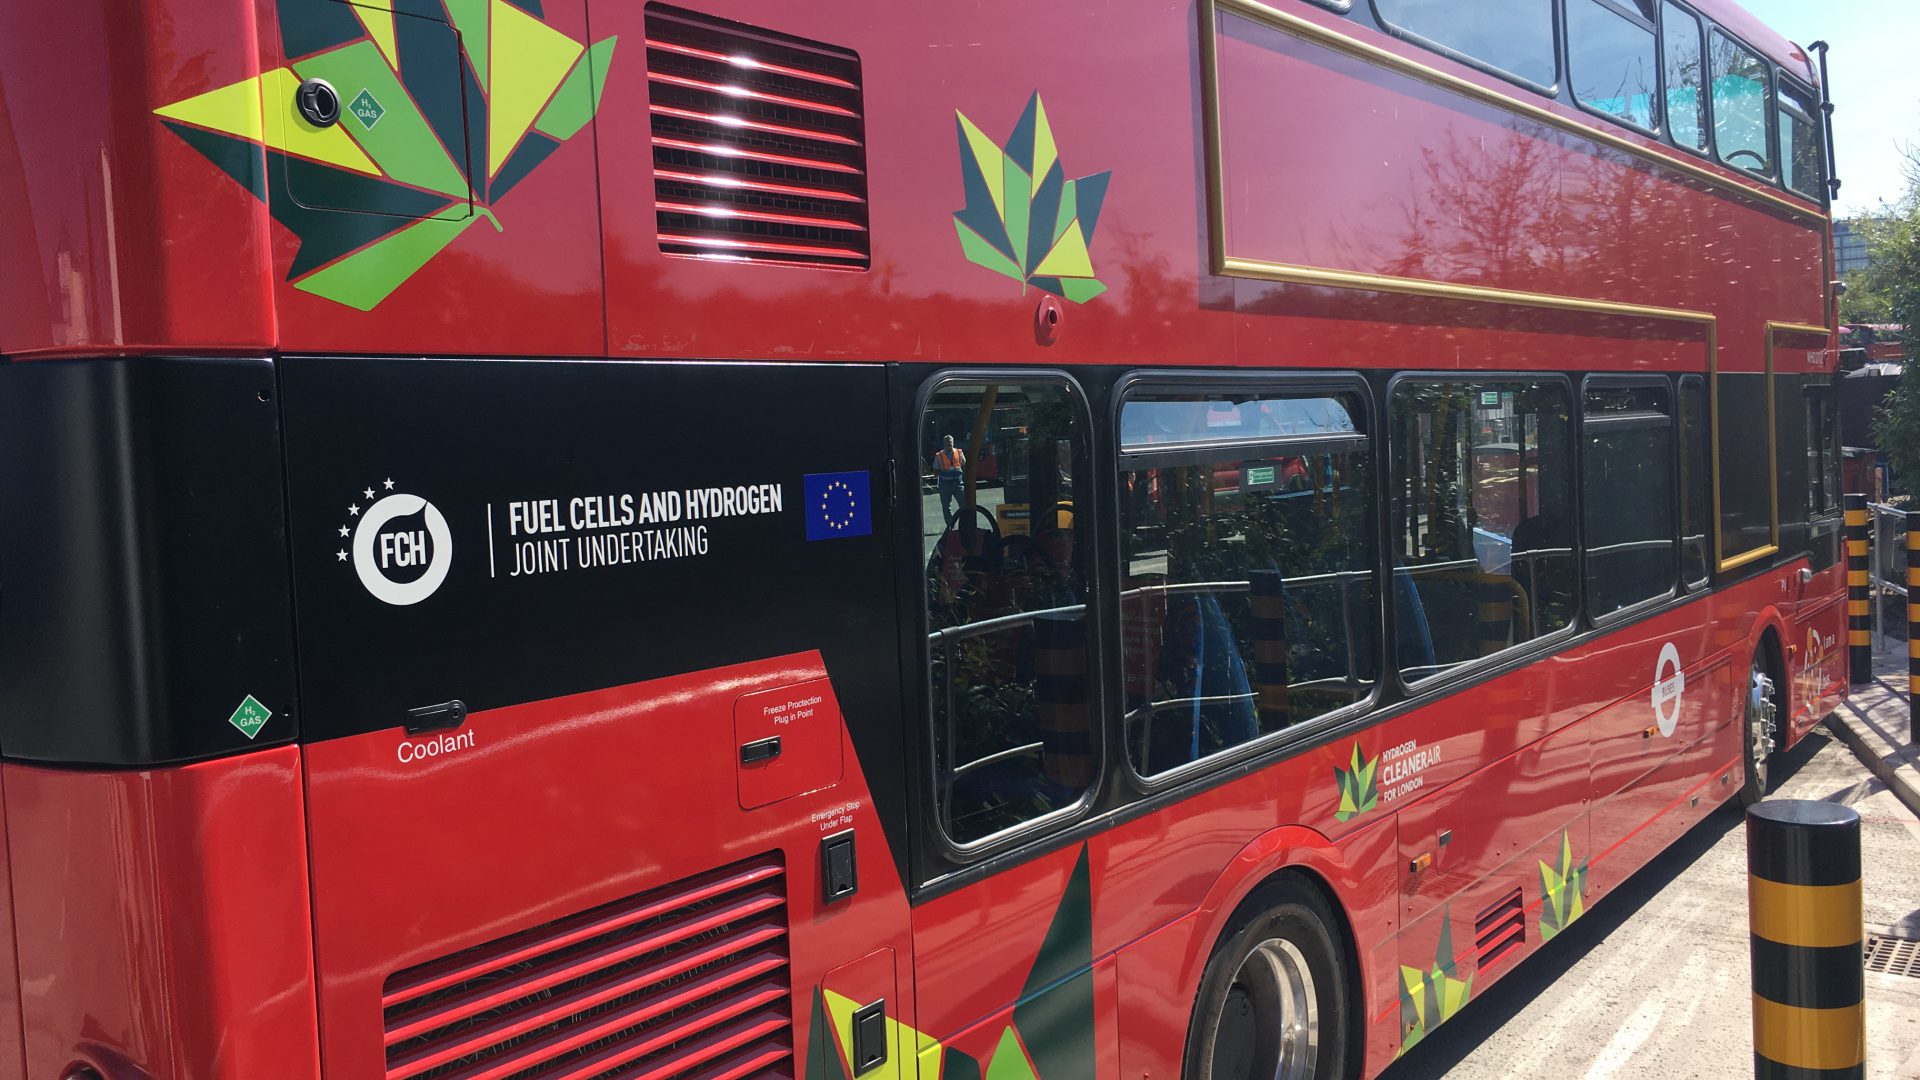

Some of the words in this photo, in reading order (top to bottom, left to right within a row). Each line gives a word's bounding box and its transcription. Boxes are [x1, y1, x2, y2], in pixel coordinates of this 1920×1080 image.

[357, 108, 377, 119] GAS
[509, 499, 566, 536] FUEL
[569, 493, 635, 531] CELLS
[638, 491, 682, 524] AND
[685, 483, 783, 520] HYDROGEN
[380, 530, 427, 569] FCH
[509, 538, 571, 577] JOINT
[577, 525, 709, 569] UNDERTAKING
[240, 715, 262, 727] GAS
[763, 704, 786, 716] Freeze
[774, 714, 789, 725] Plug
[789, 712, 796, 721] in
[797, 708, 814, 719] Point
[397, 728, 475, 764] Coolant
[1382, 738, 1417, 763] HYDROGEN
[1383, 788, 1397, 804] FOR
[1397, 775, 1424, 797] LONDON
[811, 805, 846, 823] Emergency
[846, 801, 860, 812] Stop
[820, 819, 839, 831] Under
[839, 815, 854, 825] Flap
